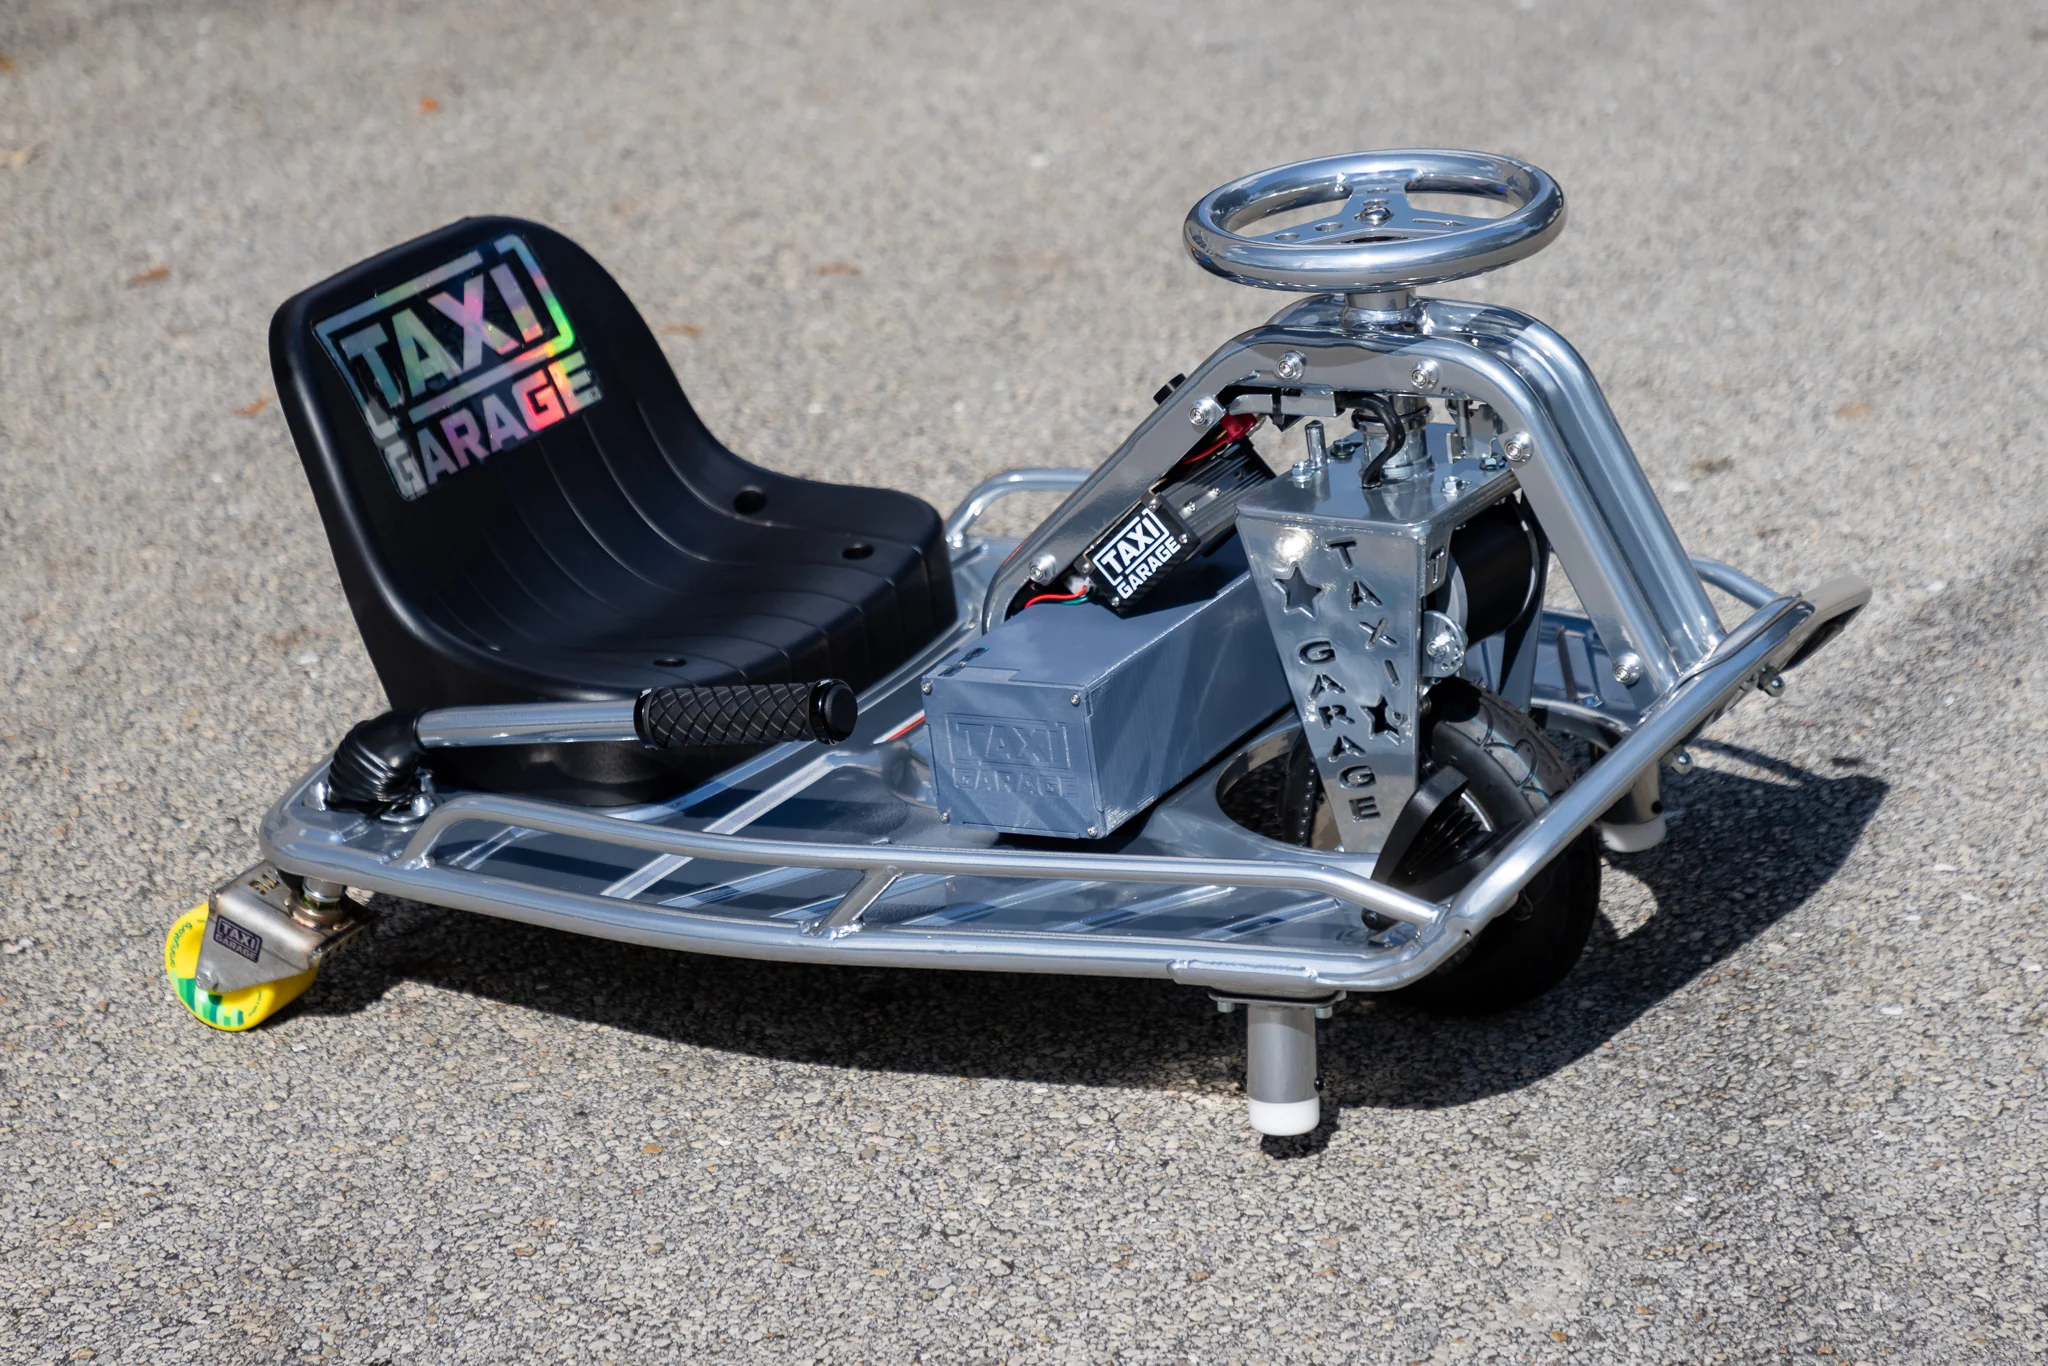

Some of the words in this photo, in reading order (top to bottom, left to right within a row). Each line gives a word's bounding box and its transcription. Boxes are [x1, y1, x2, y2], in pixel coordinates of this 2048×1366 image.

[339, 262, 544, 408] TAXI
[384, 350, 602, 499] GARAGE
[1101, 517, 1161, 575] TAXI
[1116, 536, 1181, 599] GARAGE
[1324, 538, 1399, 687] TAXI
[956, 722, 1061, 764] TAXI
[1298, 639, 1380, 822] GARAGE
[952, 767, 1079, 798] GARAGE
[215, 934, 257, 960] GARAGE
[221, 921, 256, 950] TAXI
